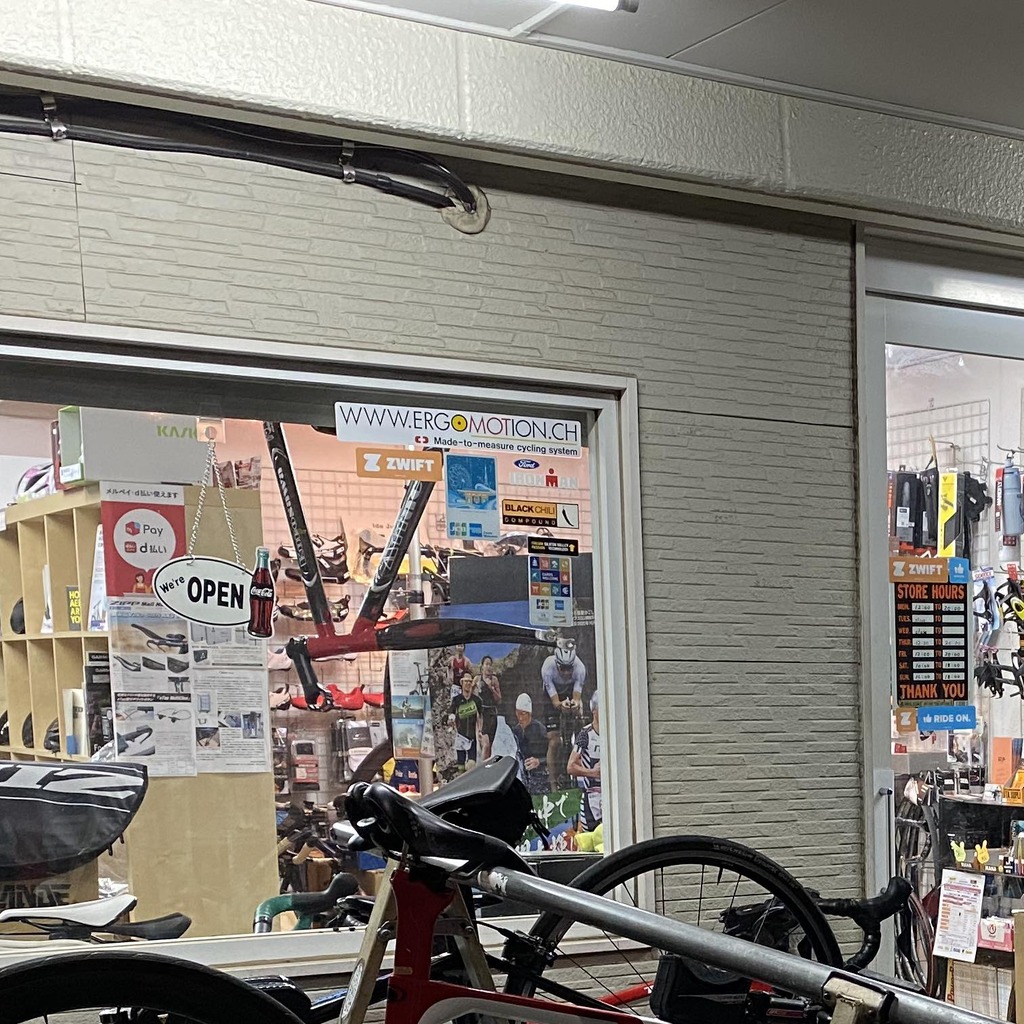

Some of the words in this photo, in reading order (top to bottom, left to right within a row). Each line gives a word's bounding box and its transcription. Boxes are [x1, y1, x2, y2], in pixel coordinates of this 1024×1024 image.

[339, 405, 578, 441] WWW.ERGOMOTION.CH
[433, 436, 514, 451] Made-to-measure
[517, 443, 547, 455] cycling
[549, 446, 578, 456] system
[386, 456, 435, 472] ZWIFT
[505, 504, 534, 513] BLACK
[535, 506, 555, 514] CHILI
[504, 517, 556, 525] COMPOUND
[143, 524, 163, 537] Pay
[909, 564, 943, 575] ZWIFT
[159, 575, 185, 594] We're
[187, 576, 244, 609] OPEN
[897, 584, 928, 600] STORE
[932, 584, 965, 600] HOURS
[900, 684, 938, 699] THANK
[942, 683, 965, 698] YOU
[934, 714, 954, 723] RIDE
[956, 714, 971, 722] ON.
